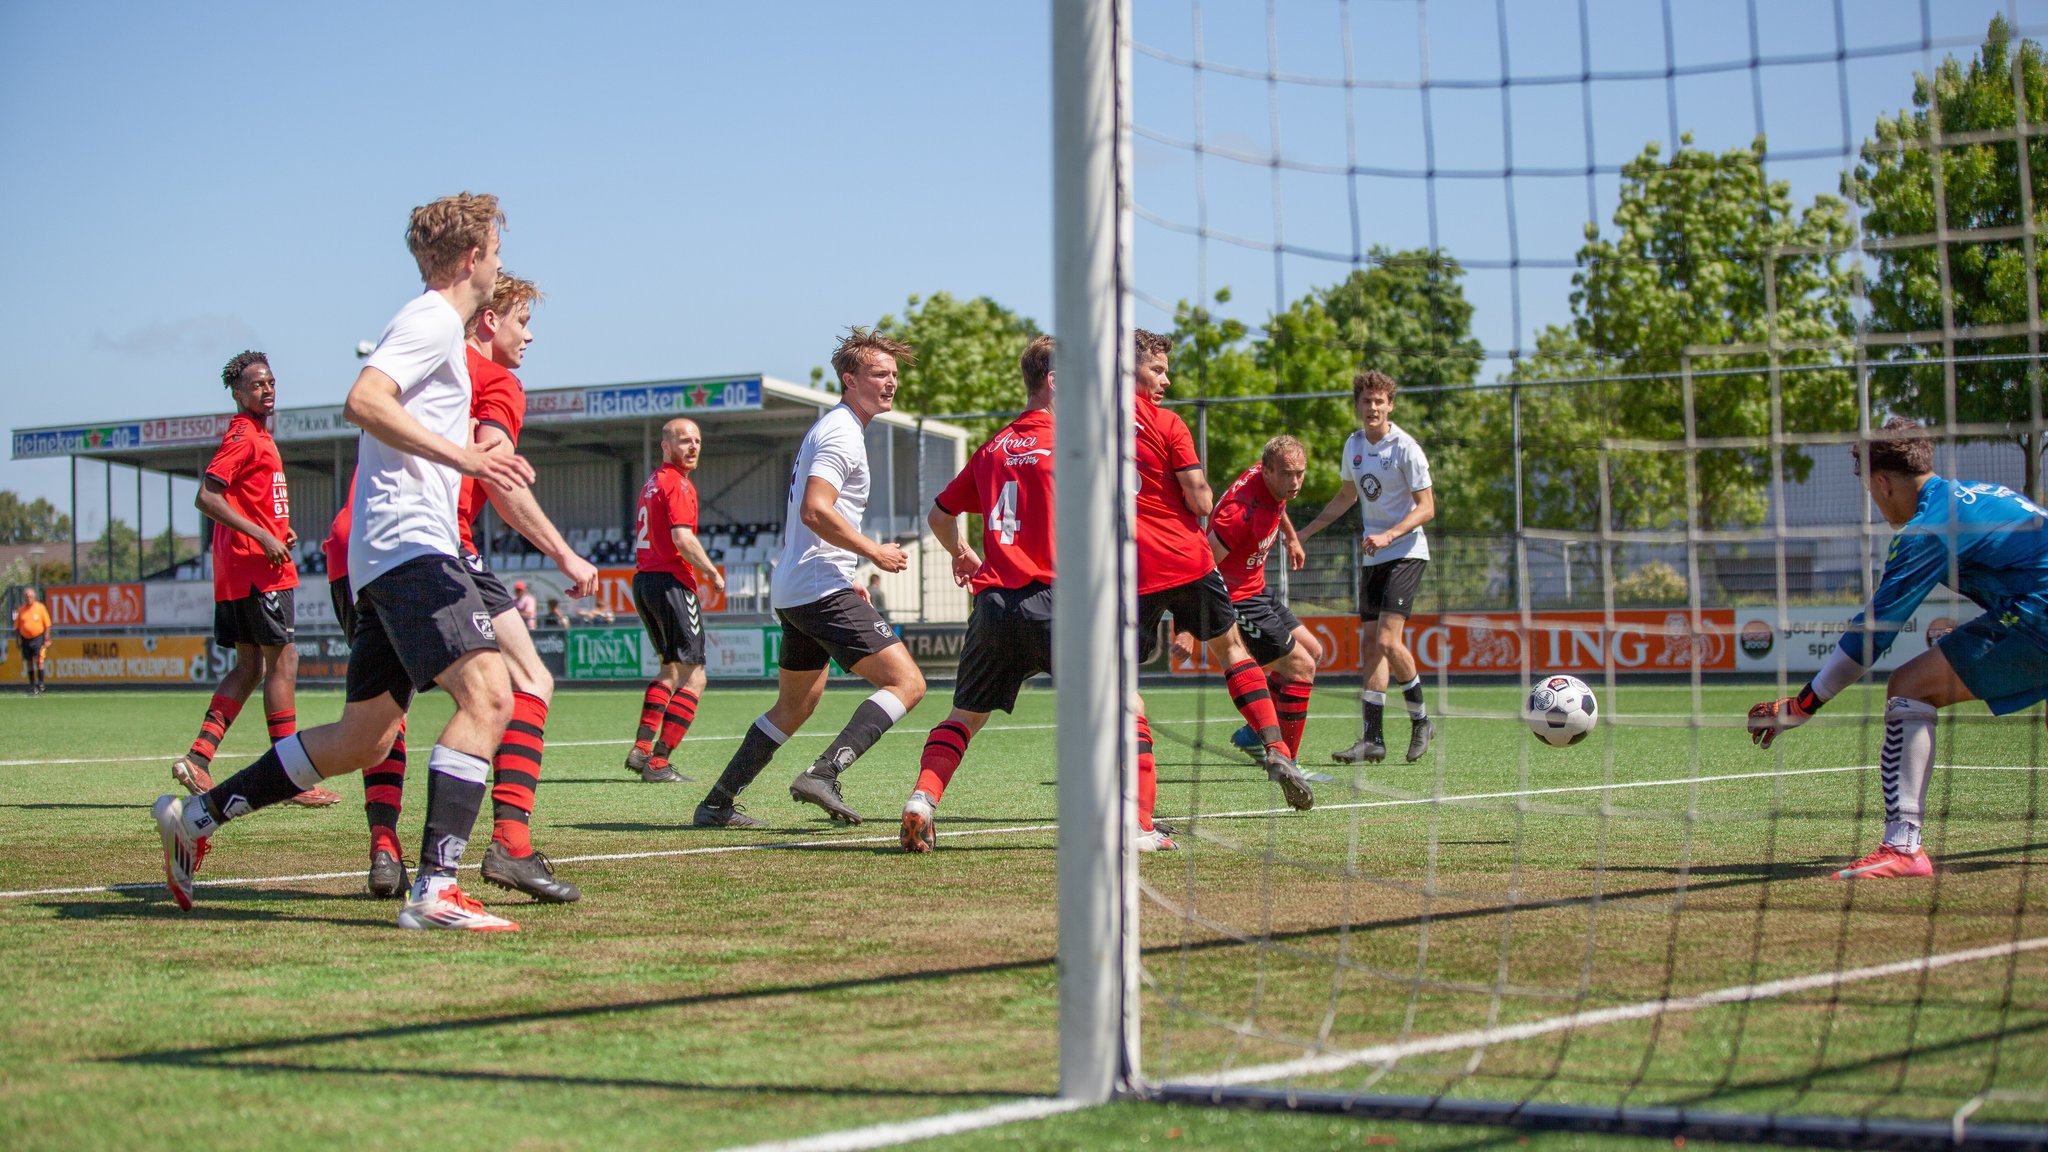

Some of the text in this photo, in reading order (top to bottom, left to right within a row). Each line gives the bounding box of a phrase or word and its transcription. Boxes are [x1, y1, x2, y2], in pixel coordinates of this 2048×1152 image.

[586, 387, 686, 415] Heineken
[181, 419, 213, 436] ESSO
[14, 430, 84, 455] Heineken
[989, 480, 1021, 545] 4
[636, 505, 650, 550] 2
[51, 593, 101, 624] ING
[601, 578, 637, 612] IN
[1783, 621, 1817, 639] your
[83, 642, 118, 658] HALLO
[1546, 624, 1649, 667] ING
